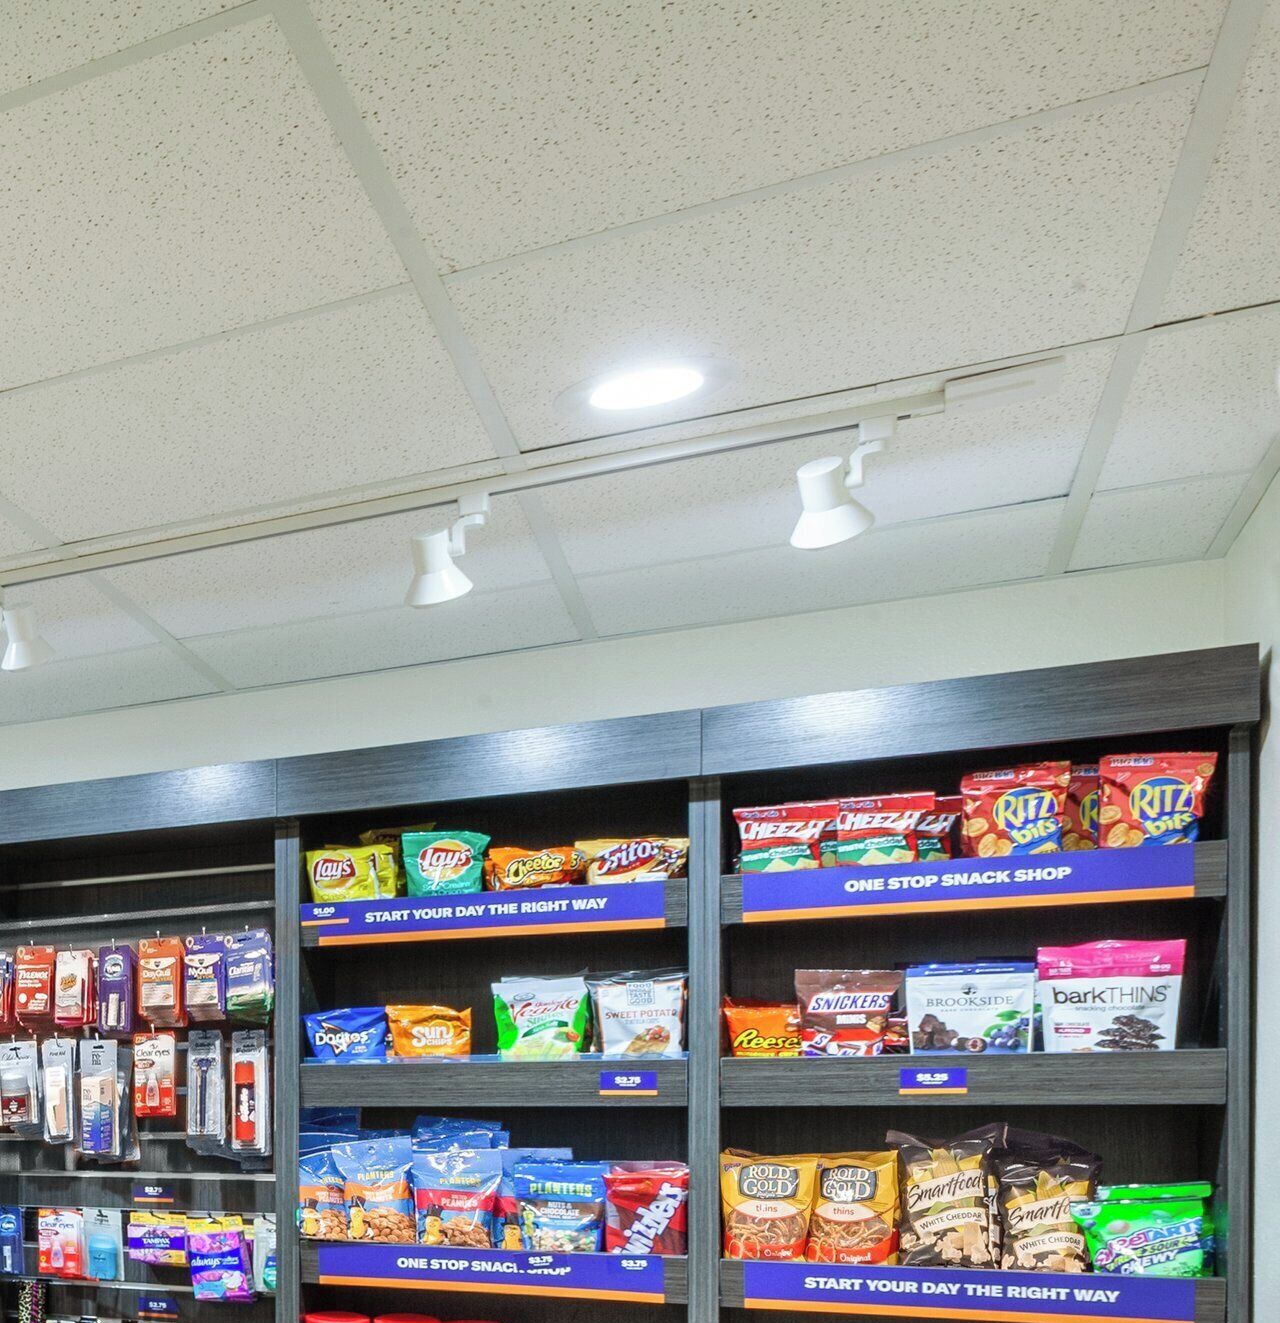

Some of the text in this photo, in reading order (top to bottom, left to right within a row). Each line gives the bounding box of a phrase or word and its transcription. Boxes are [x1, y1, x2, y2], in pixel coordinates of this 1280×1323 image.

[1130, 781, 1194, 820] RITZ
[995, 788, 1058, 829] RITZ
[1145, 810, 1193, 836] bits
[1011, 817, 1059, 846] bits
[864, 836, 905, 849] cheddar
[421, 847, 471, 869] Lay's
[597, 839, 662, 874] Fritos
[768, 846, 809, 858] cheddar
[315, 858, 356, 881] Lay's
[507, 853, 564, 884] Cheetos
[844, 866, 1072, 893] ONE STOP SNACK SHOP
[313, 907, 335, 915] $1.00
[364, 898, 607, 923] START YOUR DAY THE RIGHT WAY
[142, 968, 171, 979] DayQuil
[188, 966, 213, 978] NyQuil
[229, 966, 254, 976] Claritin
[812, 993, 890, 1011] SNICKERS
[926, 996, 1014, 1008] BROOKSIDE
[1052, 985, 1171, 1004] barkTHINS
[510, 998, 578, 1022] Veggie
[640, 1009, 677, 1018] POTATO
[836, 1013, 867, 1025] MINIS
[315, 1030, 369, 1046] Doritos
[411, 1023, 451, 1047] Sun
[426, 1037, 453, 1046] CHIPS
[136, 1048, 170, 1057] Clear eyes
[615, 1076, 641, 1084] $2.75
[358, 1171, 394, 1180] PLANTERS
[747, 1164, 792, 1181] ROLD
[828, 1165, 867, 1183] ROLD
[440, 1177, 481, 1186] PLANTERS
[741, 1177, 794, 1199] GOLD
[822, 1179, 871, 1199] GOLD
[530, 1182, 592, 1197] PLANTERS
[907, 1174, 982, 1212] Smartfood
[540, 1207, 580, 1216] CHOCOLATE
[833, 1207, 855, 1216] thins
[920, 1212, 983, 1230] WHITE CHEDDAR
[1019, 1235, 1081, 1250] WHITE CHEDDAR
[191, 1258, 221, 1270] always
[397, 1257, 428, 1270] ONE
[430, 1259, 469, 1270] STOP
[528, 1256, 553, 1264] $3.75
[621, 1260, 648, 1268] $3.75
[839, 1253, 871, 1265] Original
[804, 1276, 1120, 1303] START YOUR DAY THE RIGHT WAY
[149, 1301, 166, 1309] $2.75
